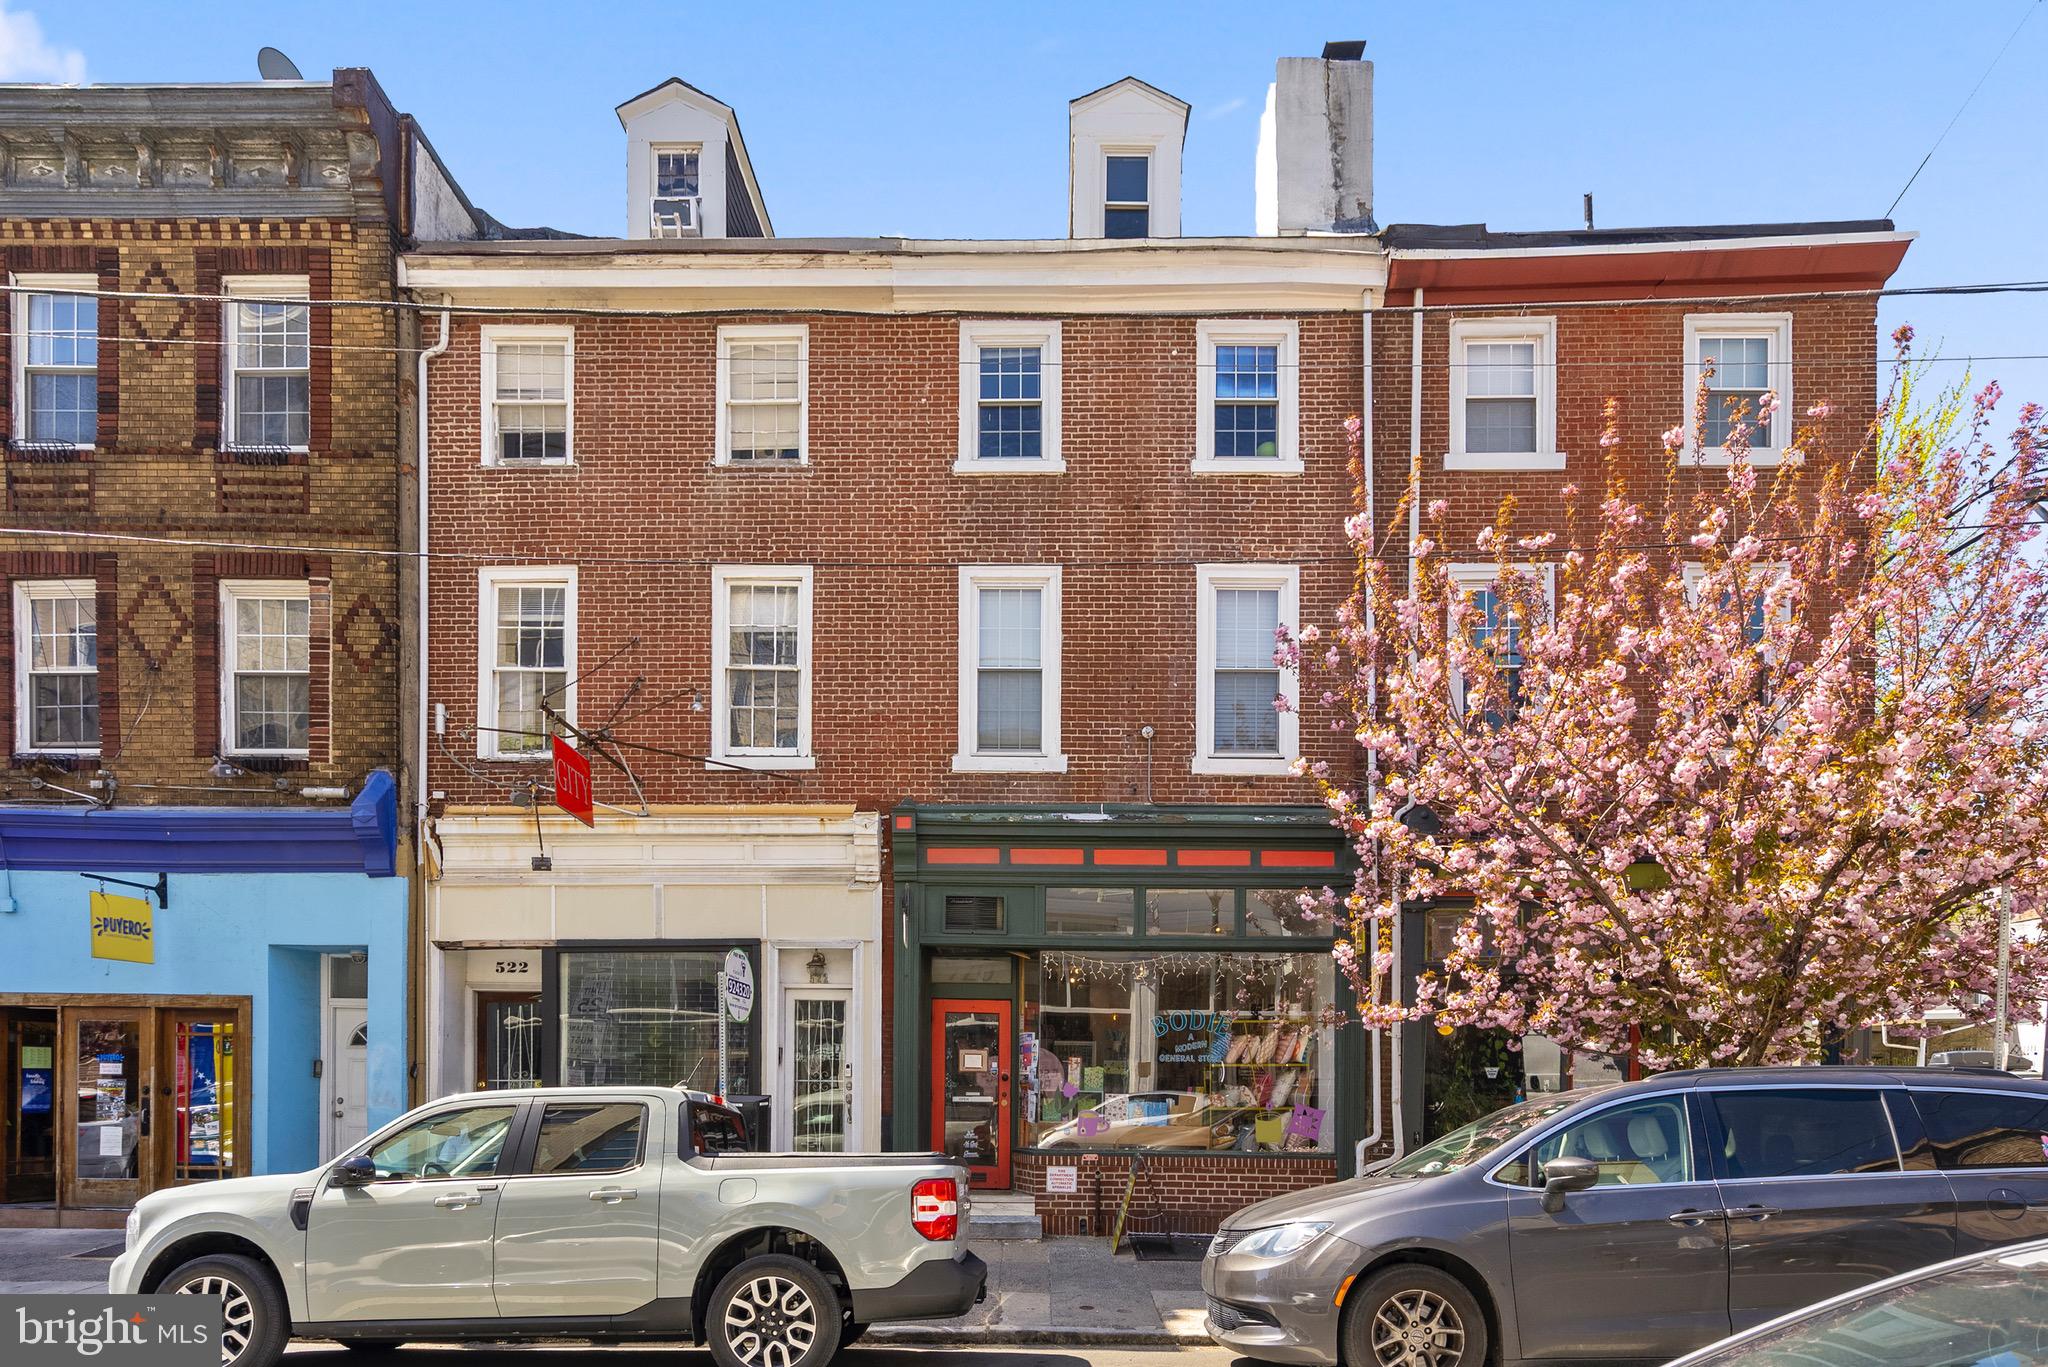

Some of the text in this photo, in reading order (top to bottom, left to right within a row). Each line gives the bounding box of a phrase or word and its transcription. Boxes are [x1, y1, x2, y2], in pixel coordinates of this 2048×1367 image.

[103, 917, 142, 936] PUYERO
[495, 961, 529, 973] 522
[1151, 1009, 1231, 1037] BODIE
[1188, 1033, 1194, 1041] A
[1175, 1041, 1208, 1053] MODERN
[1159, 1054, 1195, 1062] GENERAL
